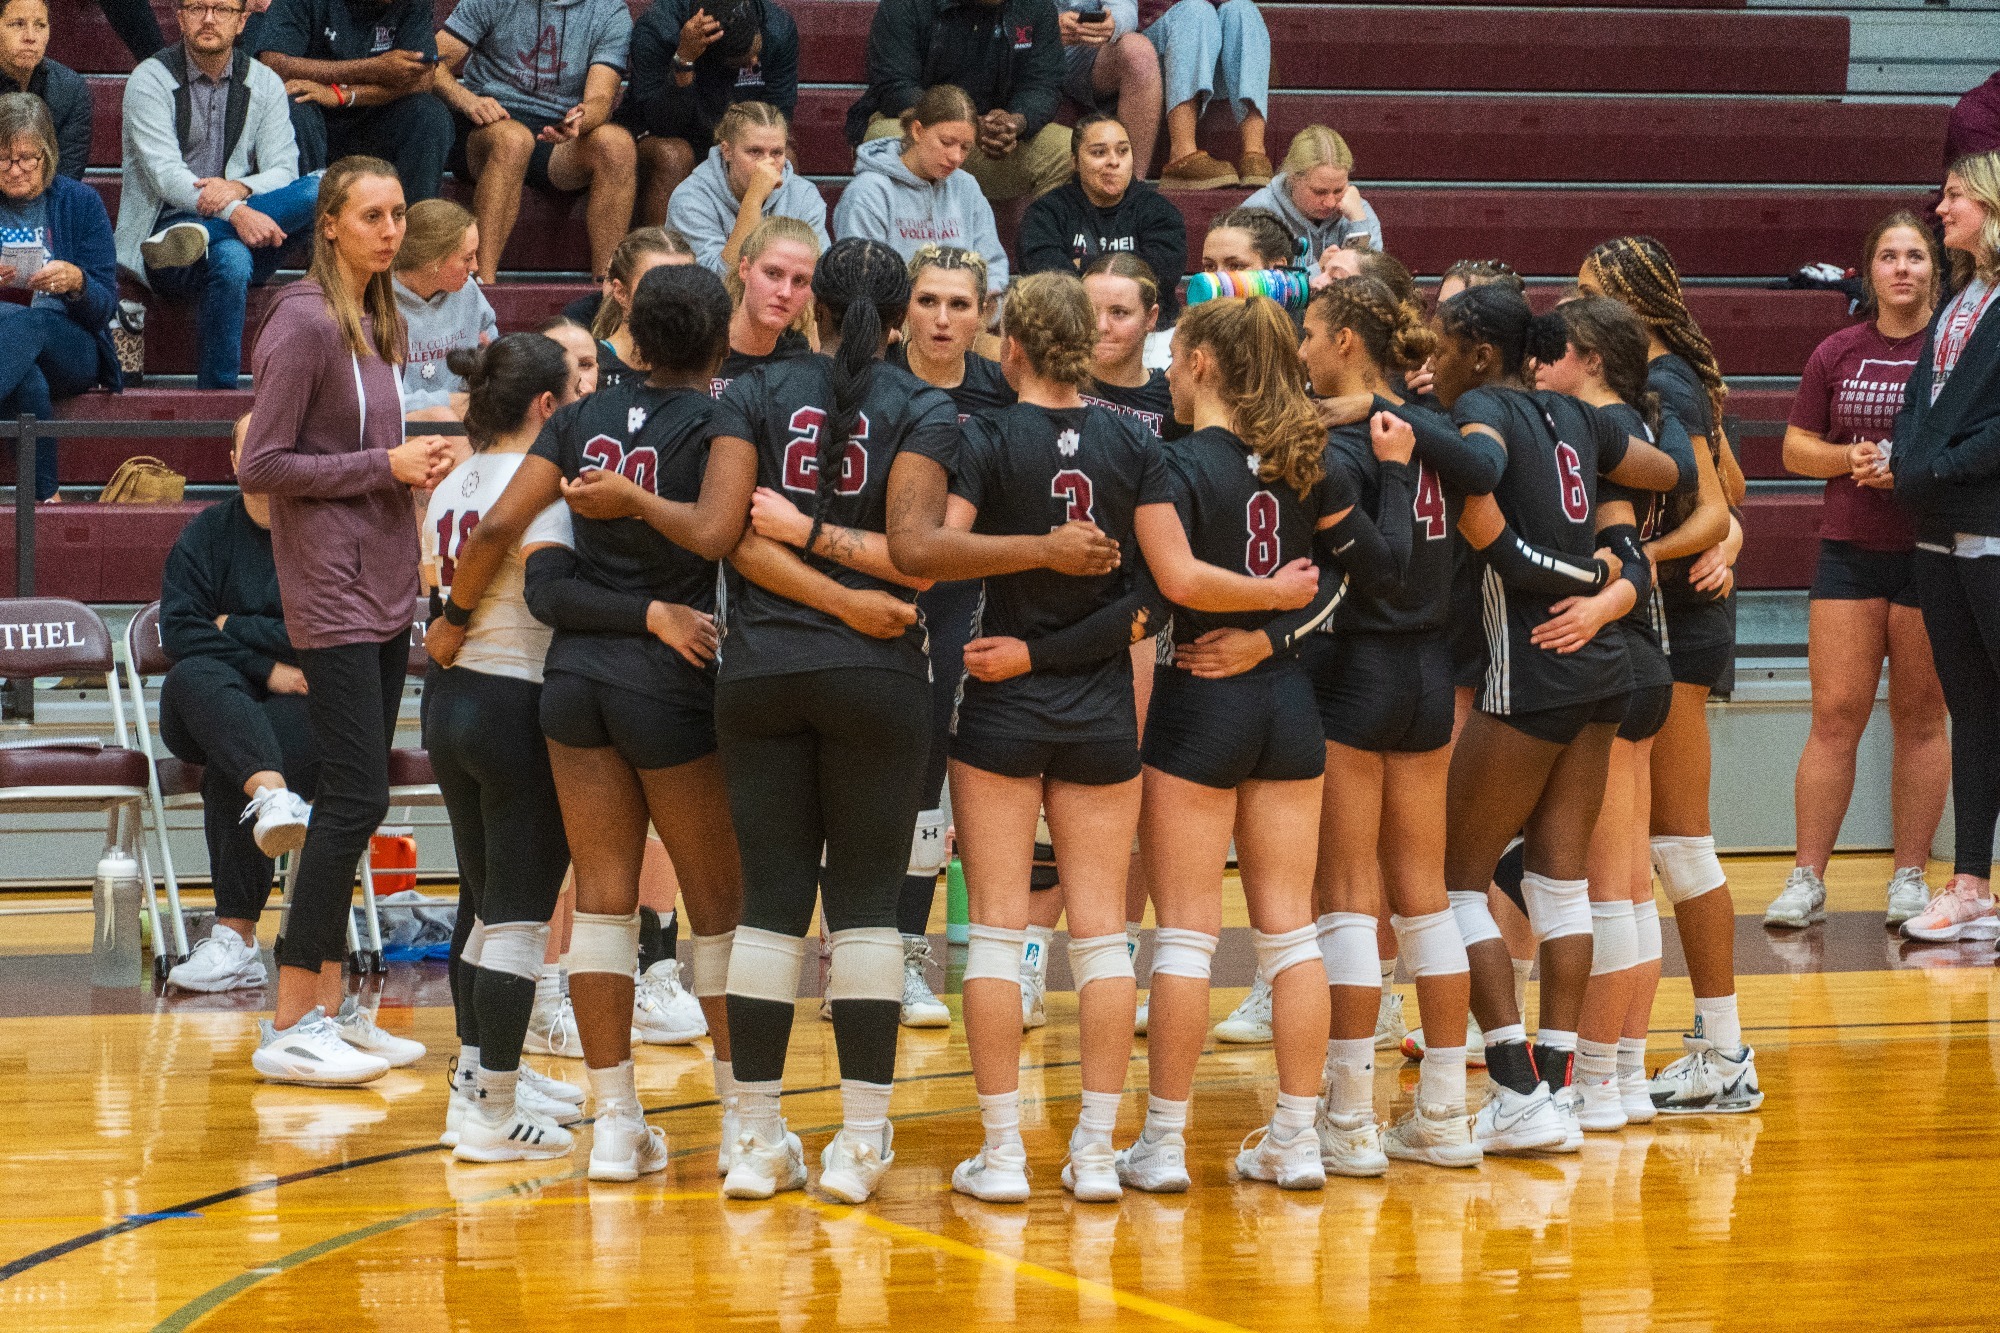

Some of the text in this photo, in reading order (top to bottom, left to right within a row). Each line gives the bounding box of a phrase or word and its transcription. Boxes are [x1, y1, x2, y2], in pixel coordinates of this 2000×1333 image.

[1051, 469, 1096, 532] 3
[1555, 440, 1589, 523] 6
[1246, 490, 1280, 578] 8
